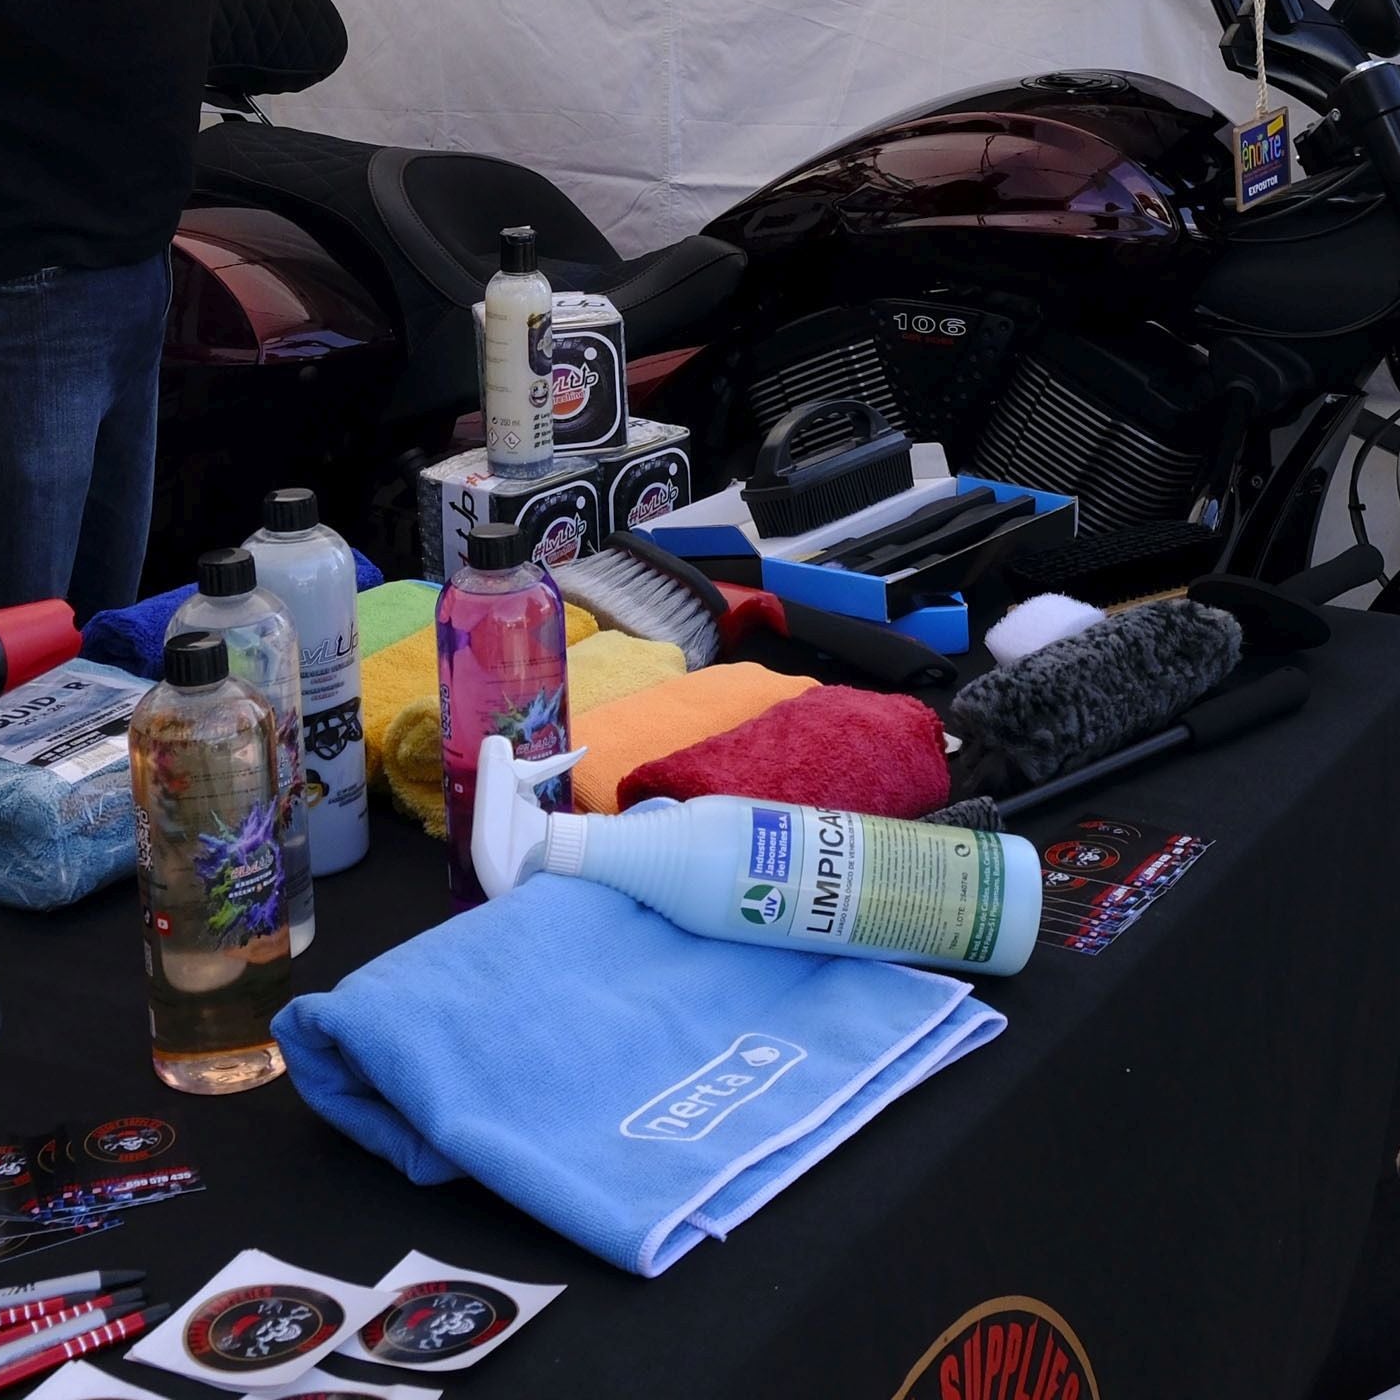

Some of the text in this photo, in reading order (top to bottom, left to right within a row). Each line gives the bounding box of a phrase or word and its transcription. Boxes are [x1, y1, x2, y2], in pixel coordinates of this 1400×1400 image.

[1248, 175, 1278, 198] EXPOSITOR
[893, 313, 967, 336] 106
[754, 828, 767, 874] Industrial
[765, 831, 778, 877] Jabonera
[778, 831, 788, 859] Valles
[777, 860, 787, 878] del
[849, 860, 855, 870] DE
[645, 1066, 754, 1136] nerta
